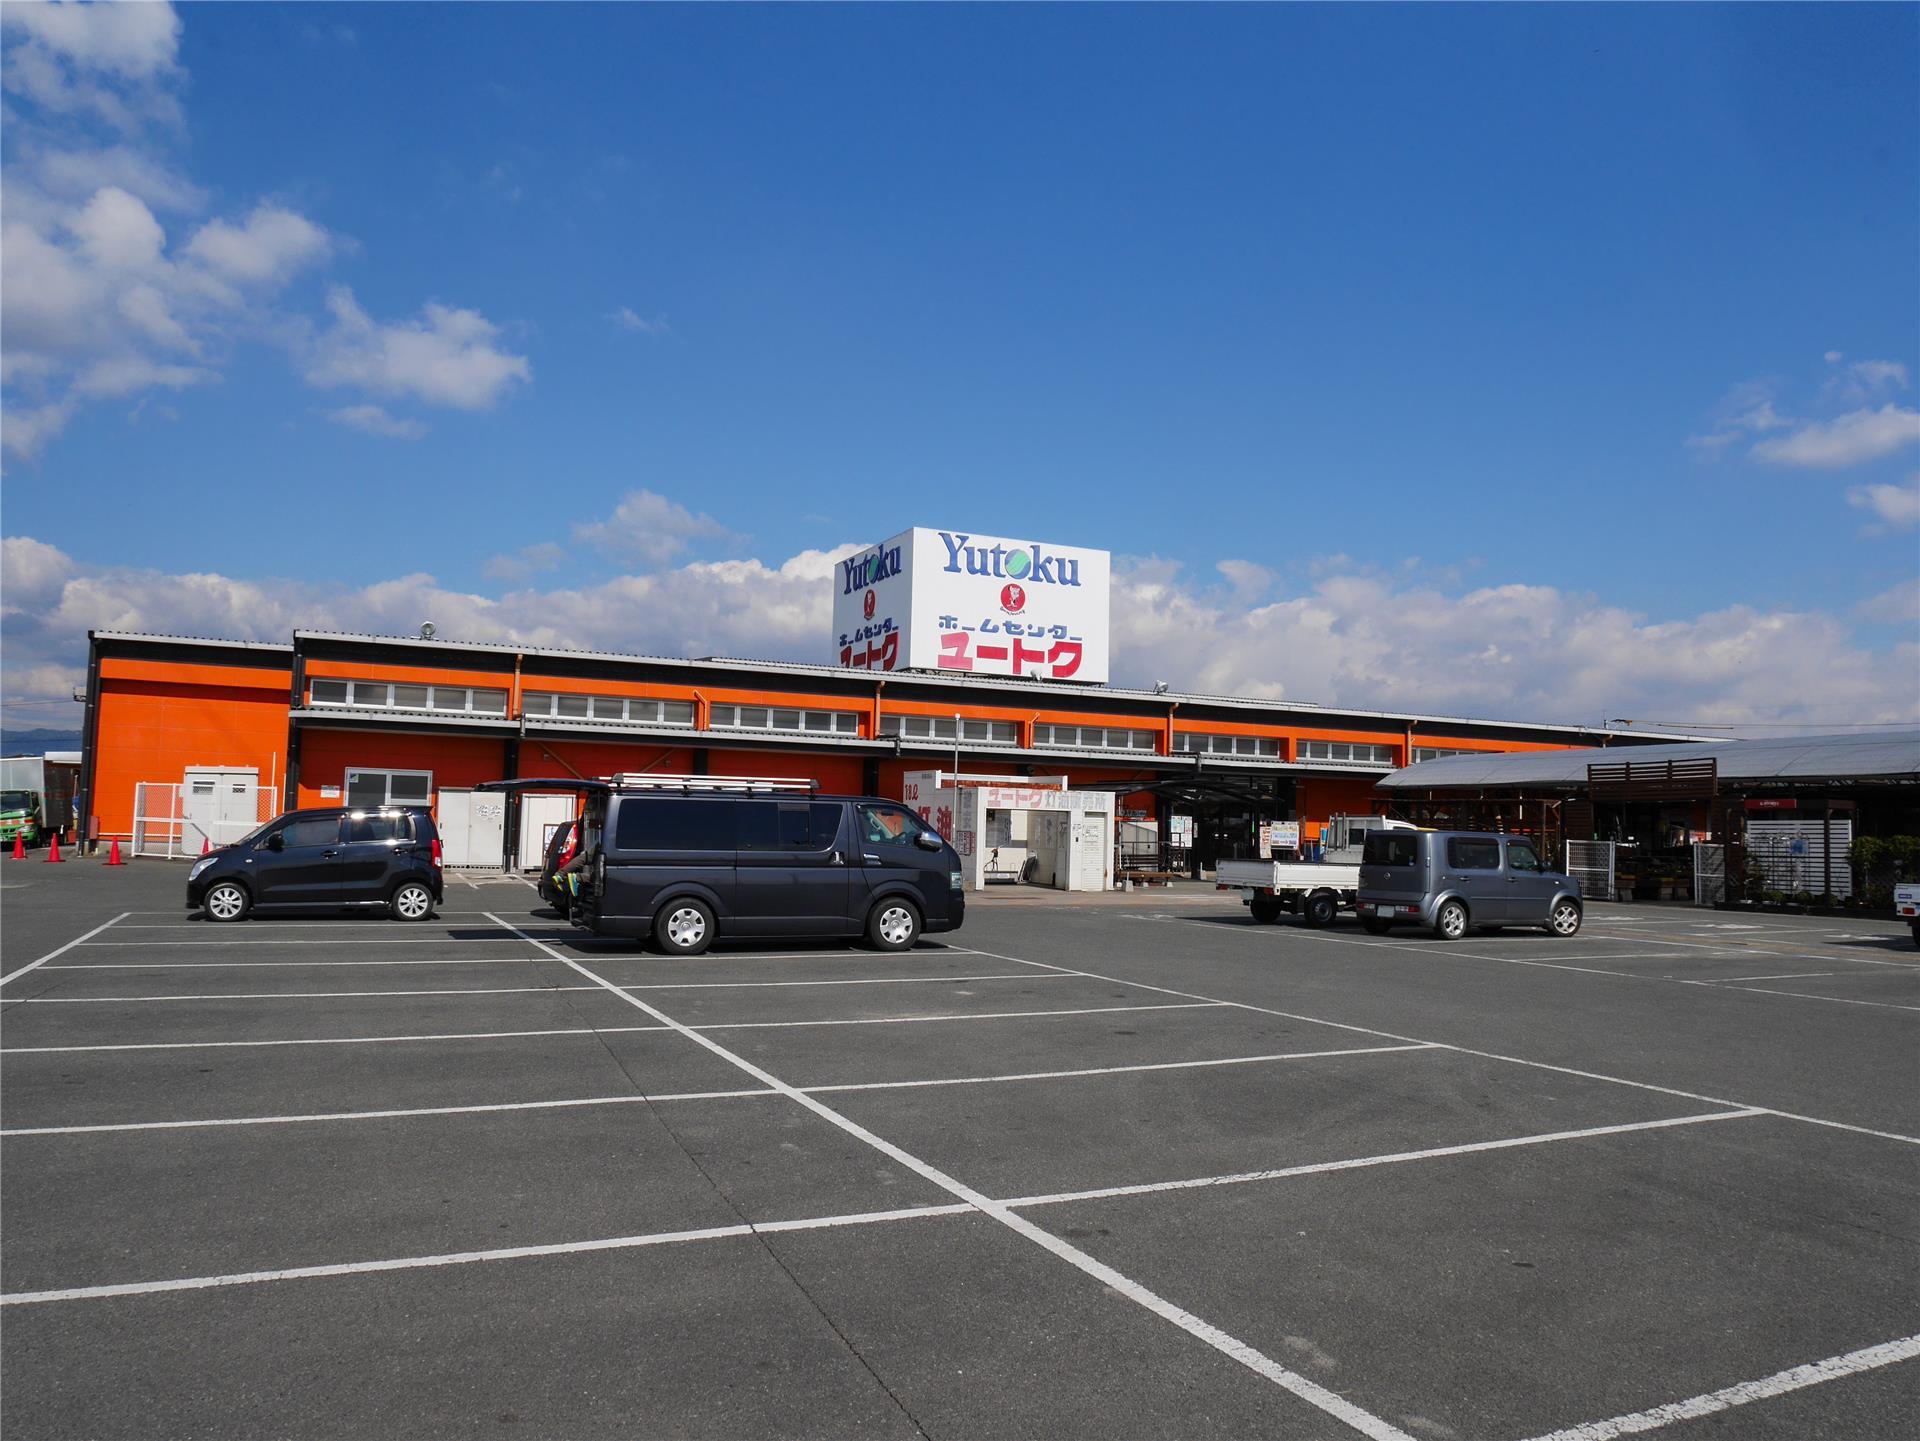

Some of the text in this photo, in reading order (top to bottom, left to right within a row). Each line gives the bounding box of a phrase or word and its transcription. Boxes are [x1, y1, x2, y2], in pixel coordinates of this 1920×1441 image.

[843, 543, 901, 594] Yutoku
[938, 532, 1081, 586] Yutoku
[839, 617, 898, 646] ホームセンター
[938, 615, 1082, 640] ホームセンター
[937, 631, 1082, 678] ユートク
